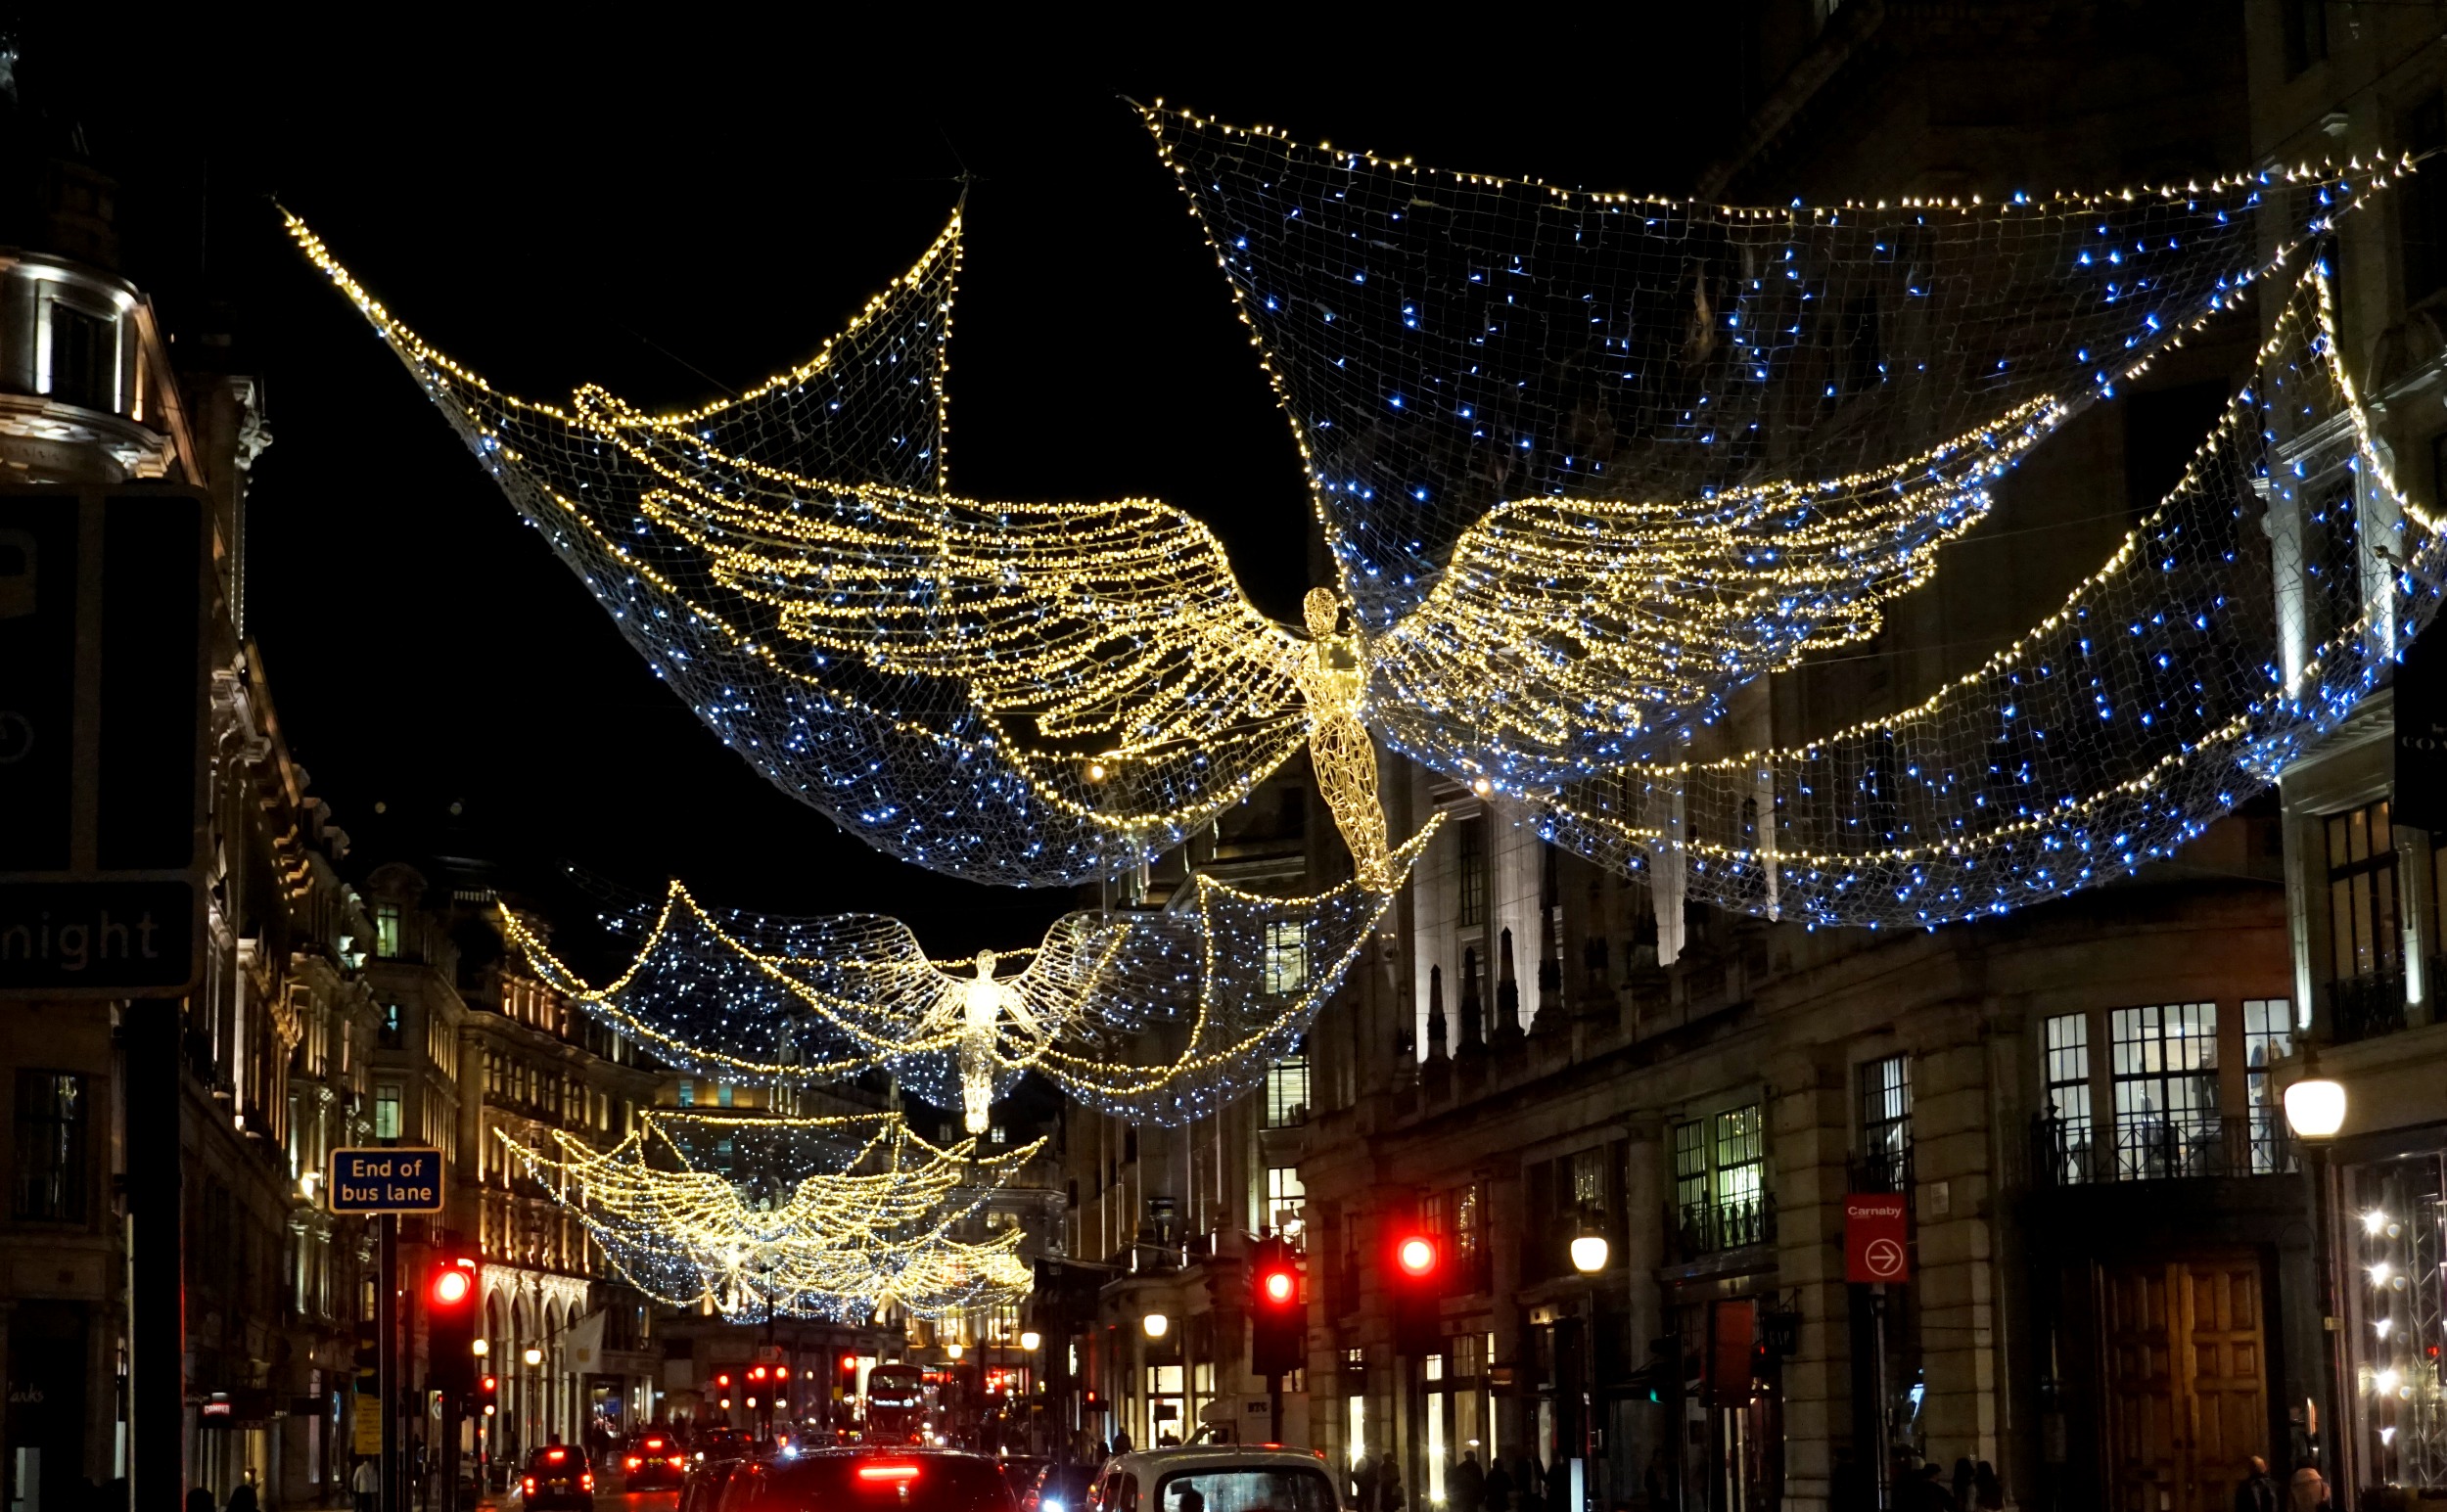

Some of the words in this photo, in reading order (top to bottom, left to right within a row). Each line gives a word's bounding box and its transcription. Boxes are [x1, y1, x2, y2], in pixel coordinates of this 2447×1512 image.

[2402, 735, 2447, 752] CO
[2, 908, 160, 971] night
[352, 1159, 392, 1177] End
[399, 1159, 424, 1177] of
[342, 1183, 380, 1202] bus
[387, 1182, 433, 1202] lane
[1847, 1206, 1903, 1219] Carnaby
